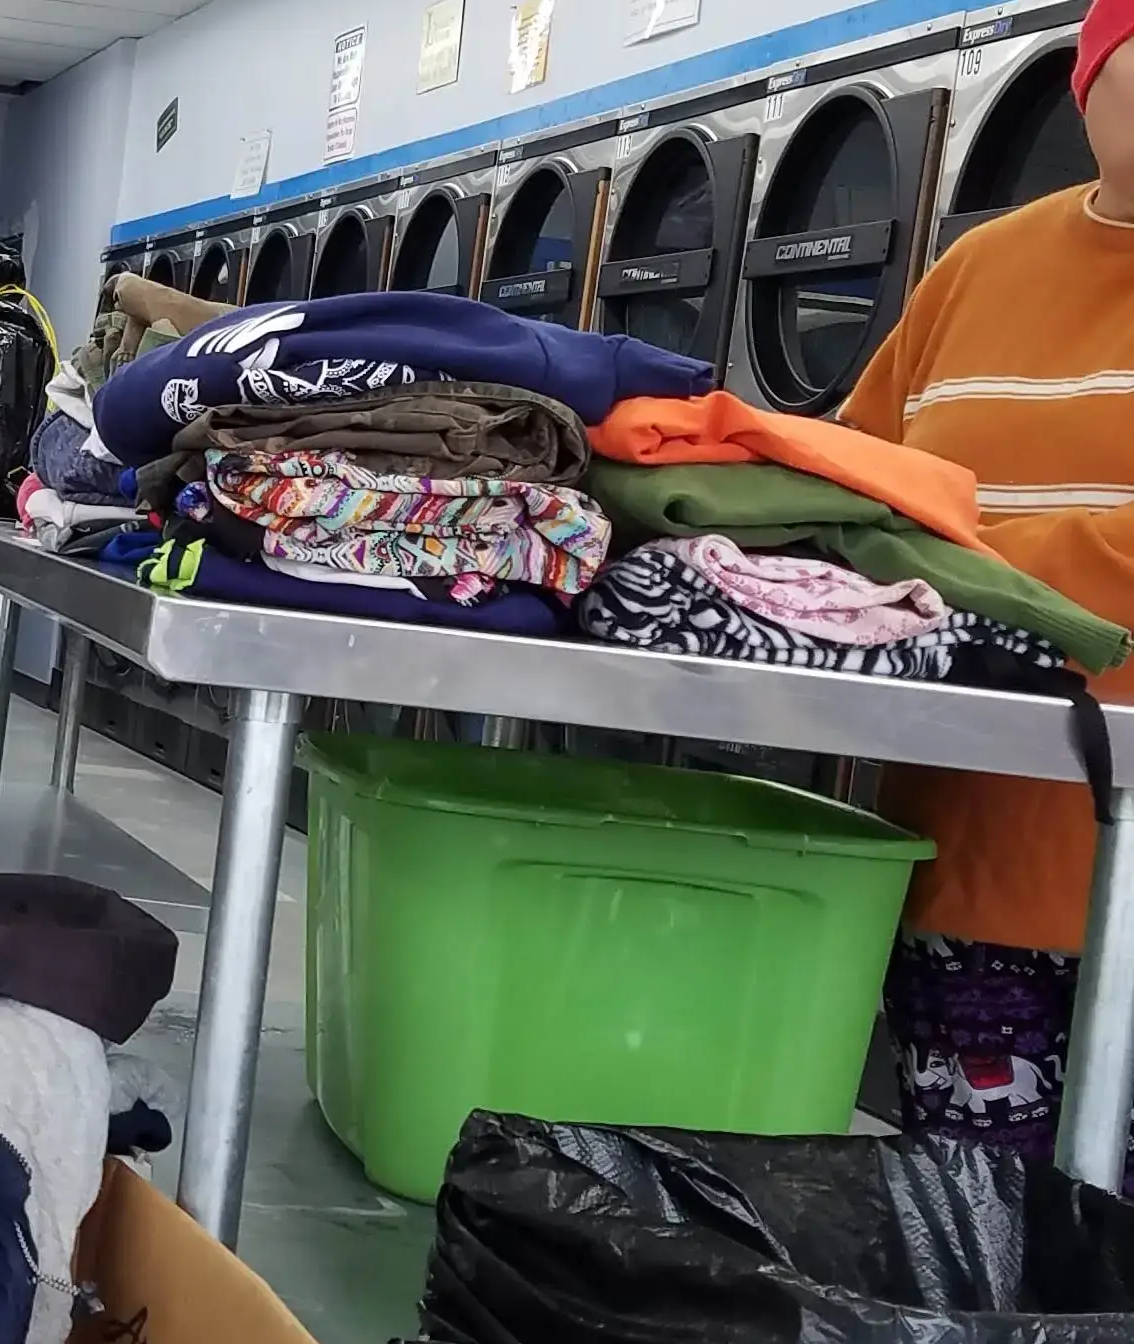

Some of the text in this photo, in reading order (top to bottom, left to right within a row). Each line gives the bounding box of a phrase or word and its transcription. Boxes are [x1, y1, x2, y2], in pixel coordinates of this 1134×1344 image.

[961, 48, 982, 77] 109
[766, 94, 783, 120] 111
[775, 236, 852, 260] CONTINENTAL
